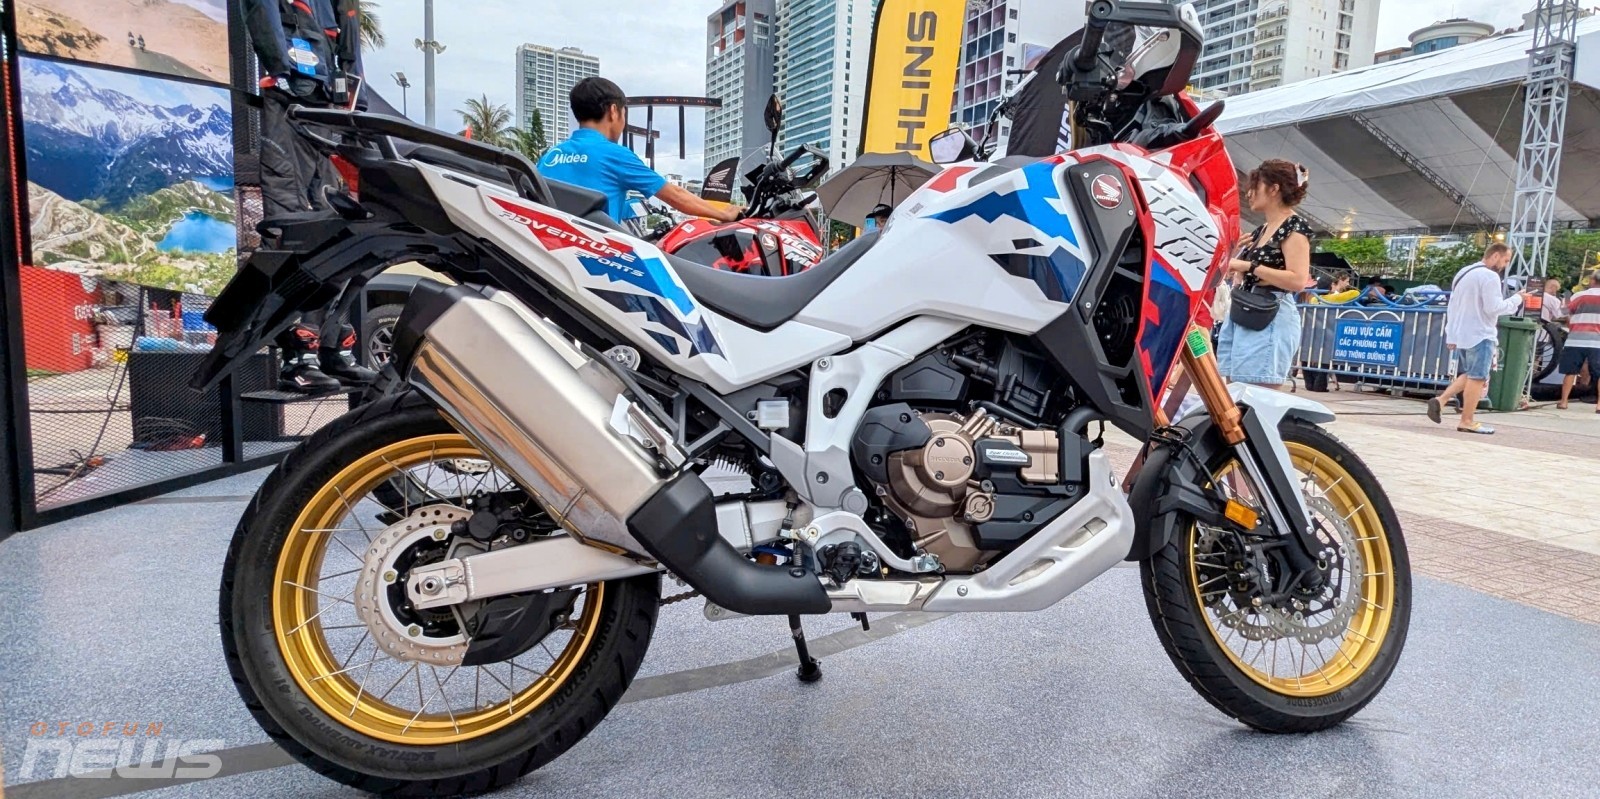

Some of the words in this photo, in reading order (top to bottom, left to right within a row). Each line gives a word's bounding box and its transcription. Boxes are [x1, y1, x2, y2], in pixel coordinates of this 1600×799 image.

[545, 151, 588, 166] Midea
[1096, 194, 1119, 203] HONDA
[499, 210, 637, 263] ADVENTURE
[574, 250, 645, 278] SPORTS
[1343, 325, 1357, 336] KHU
[1360, 326, 1374, 338] VỰC
[1375, 325, 1392, 338] CẤM
[1339, 337, 1351, 347] CÁC
[1352, 339, 1377, 349] PHƯƠNG
[1379, 340, 1394, 351] TIỆN
[1334, 349, 1347, 357] GIAO
[1348, 350, 1366, 359] THÔNG
